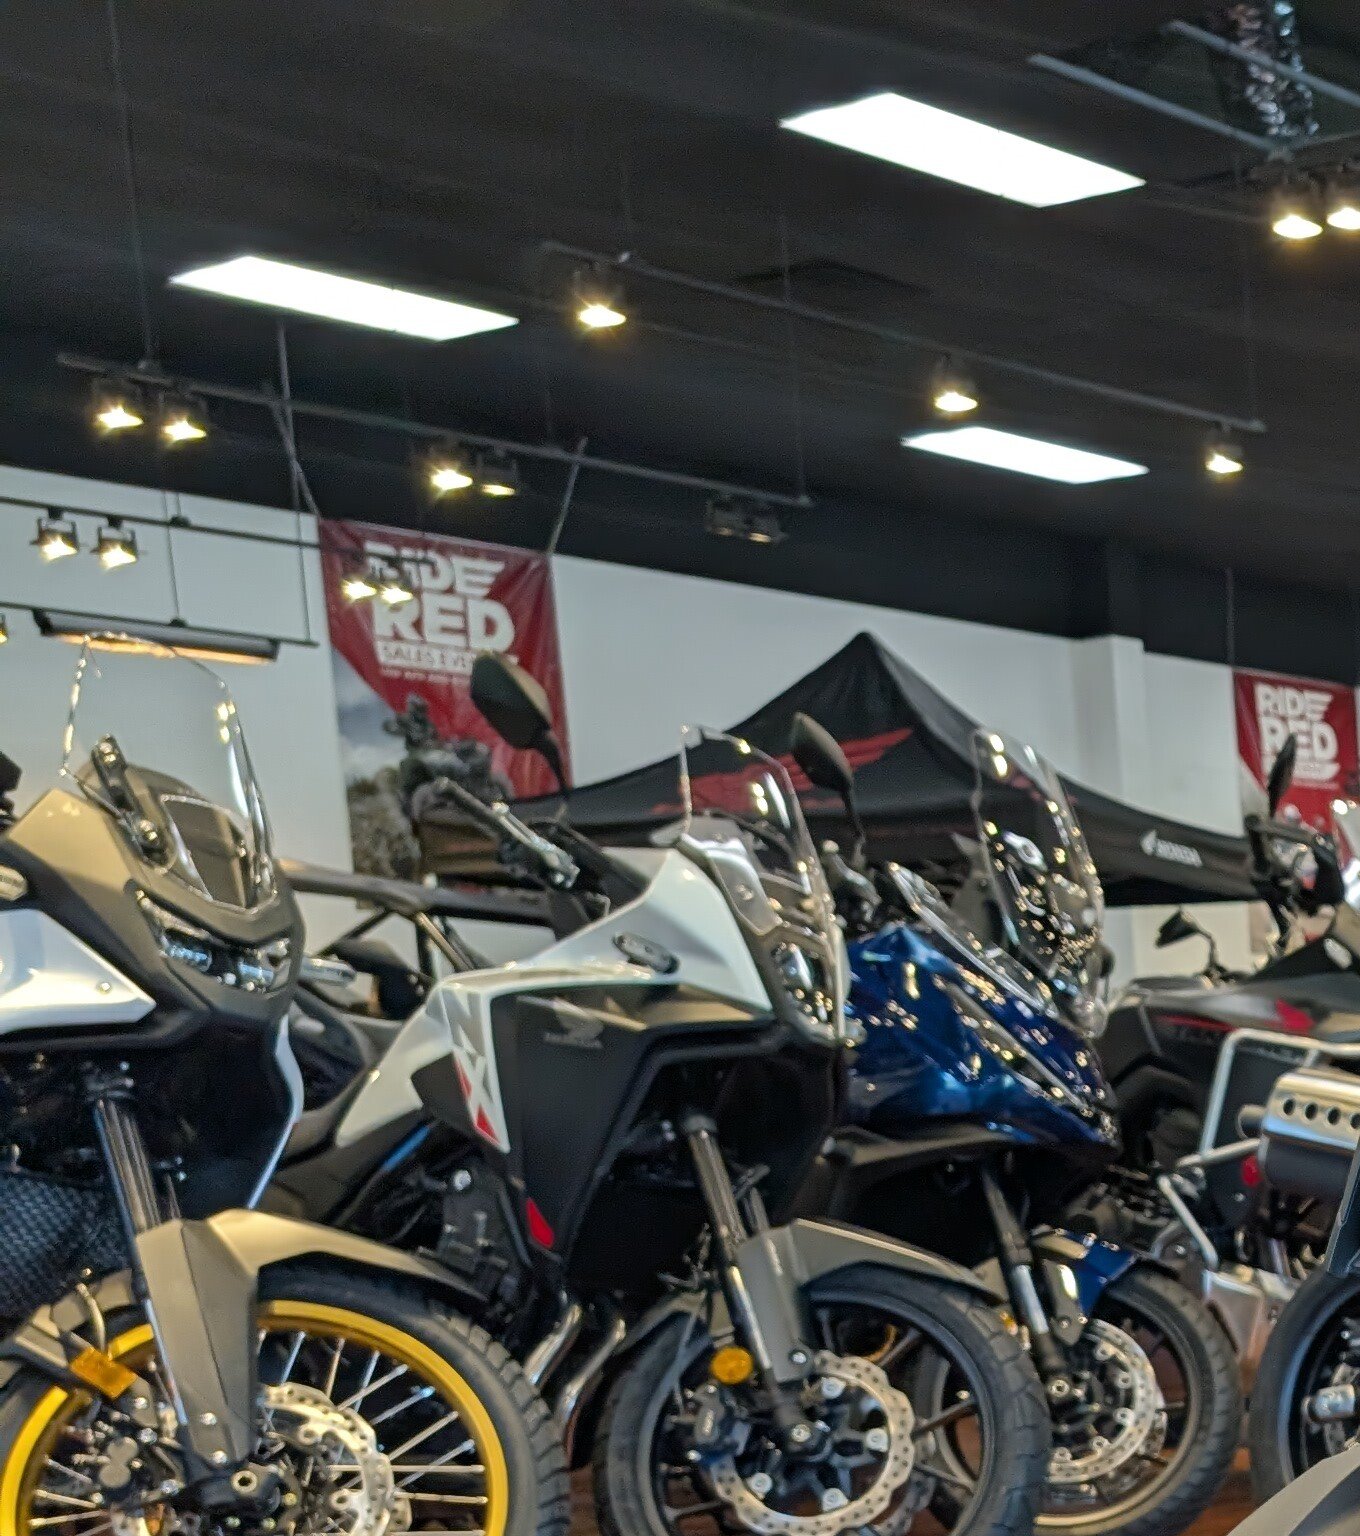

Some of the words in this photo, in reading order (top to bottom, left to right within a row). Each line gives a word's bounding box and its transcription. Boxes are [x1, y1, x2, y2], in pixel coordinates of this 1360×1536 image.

[371, 589, 515, 652] RED
[1254, 682, 1334, 721] RIDE
[1260, 716, 1339, 761] RED
